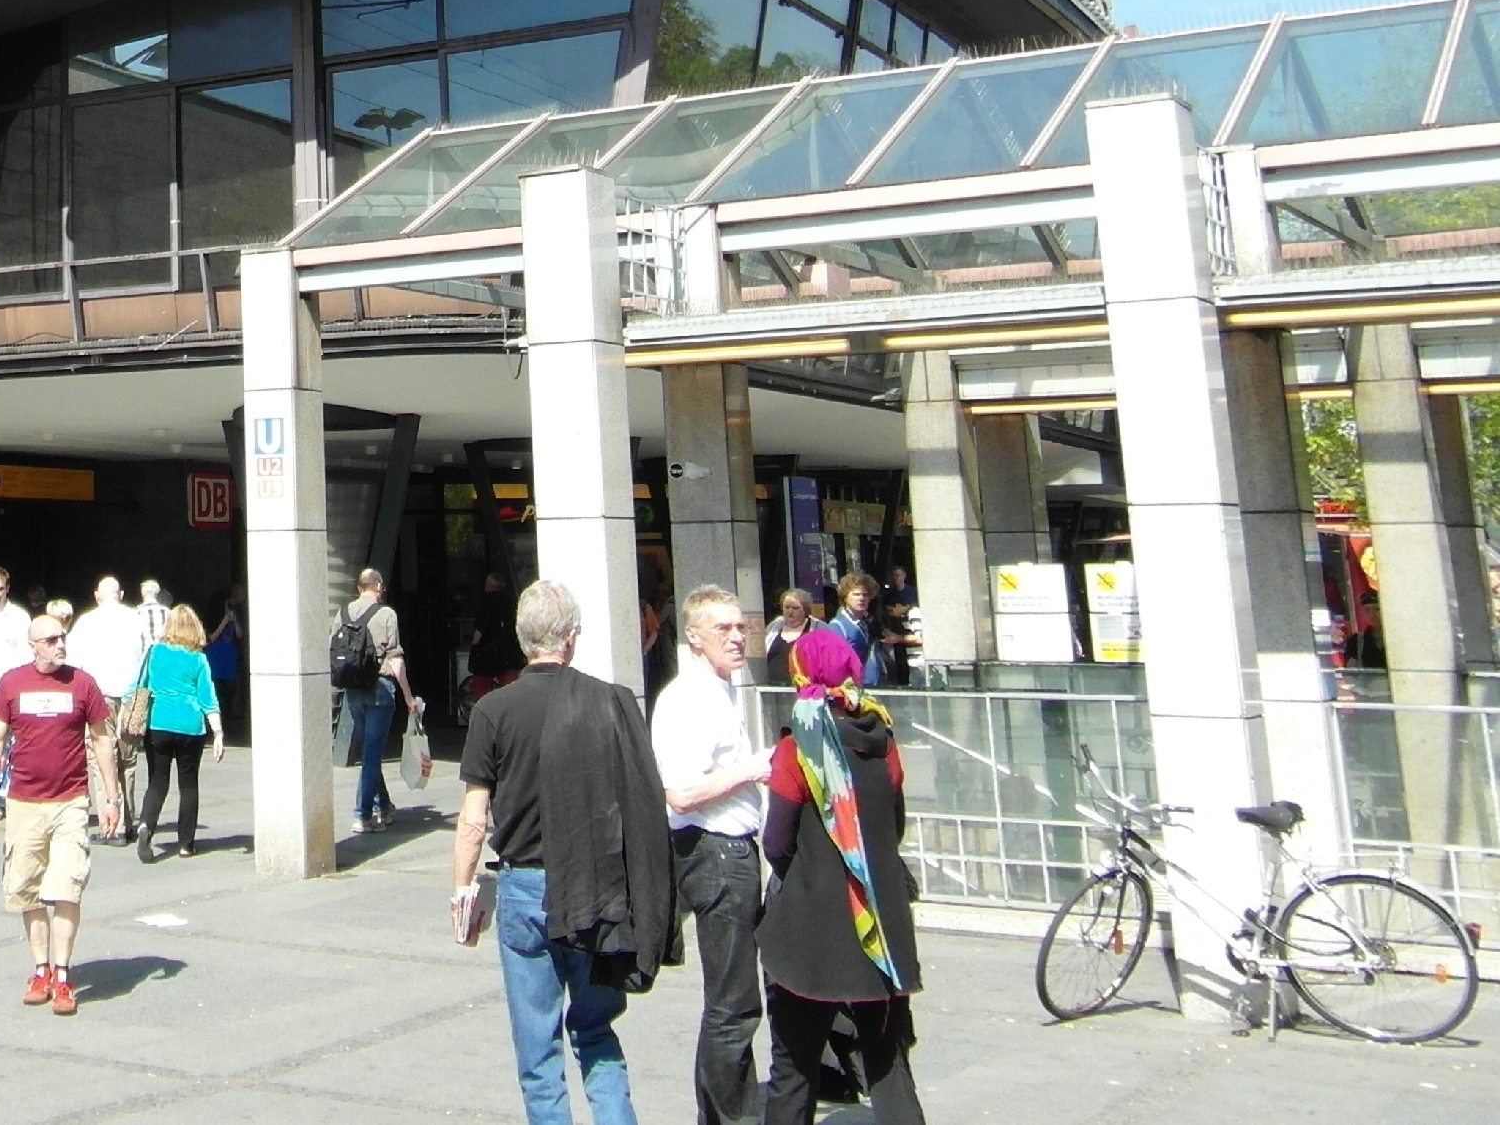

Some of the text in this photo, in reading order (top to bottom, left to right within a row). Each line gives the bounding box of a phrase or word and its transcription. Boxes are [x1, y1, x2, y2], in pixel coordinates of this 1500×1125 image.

[257, 418, 282, 455] U
[259, 458, 283, 475] U2
[197, 481, 228, 519] DB
